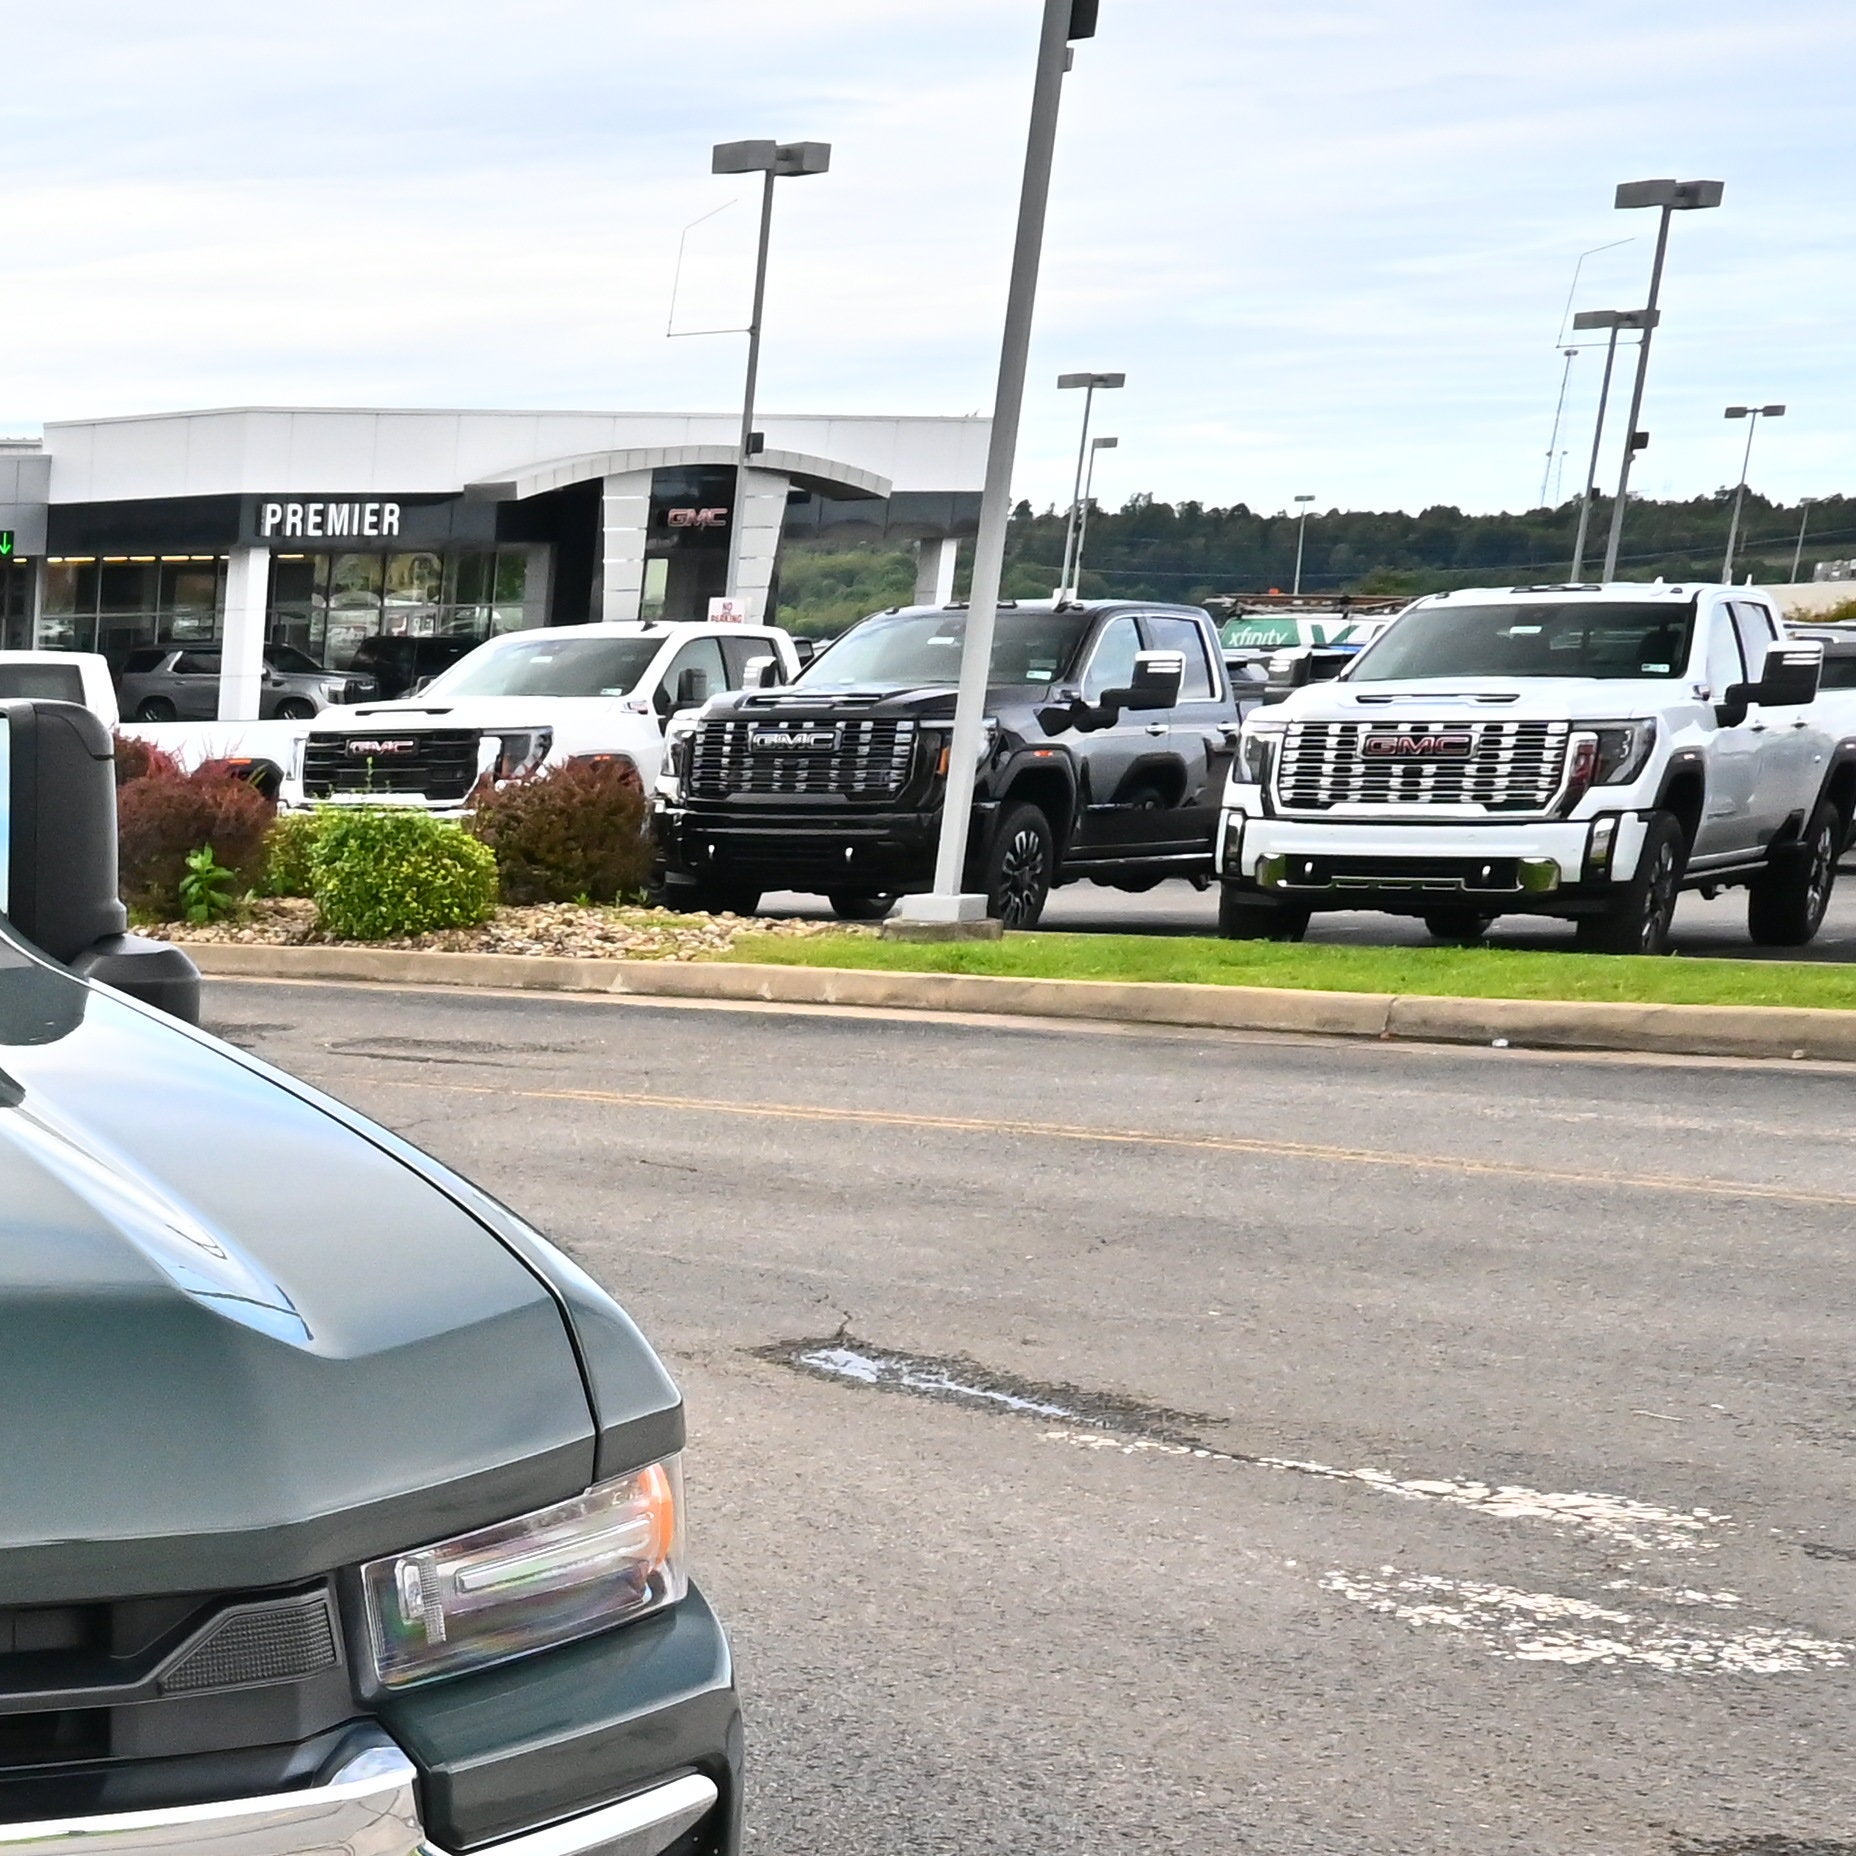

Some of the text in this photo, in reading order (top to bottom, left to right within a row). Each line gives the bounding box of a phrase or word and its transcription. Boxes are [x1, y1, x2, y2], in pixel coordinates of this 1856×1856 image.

[262, 502, 401, 537] PREMIER
[668, 508, 728, 527] GMC
[1229, 626, 1288, 647] xfinity
[349, 741, 414, 755] GMC
[752, 732, 834, 750] GMC
[1367, 736, 1470, 755] GMC
